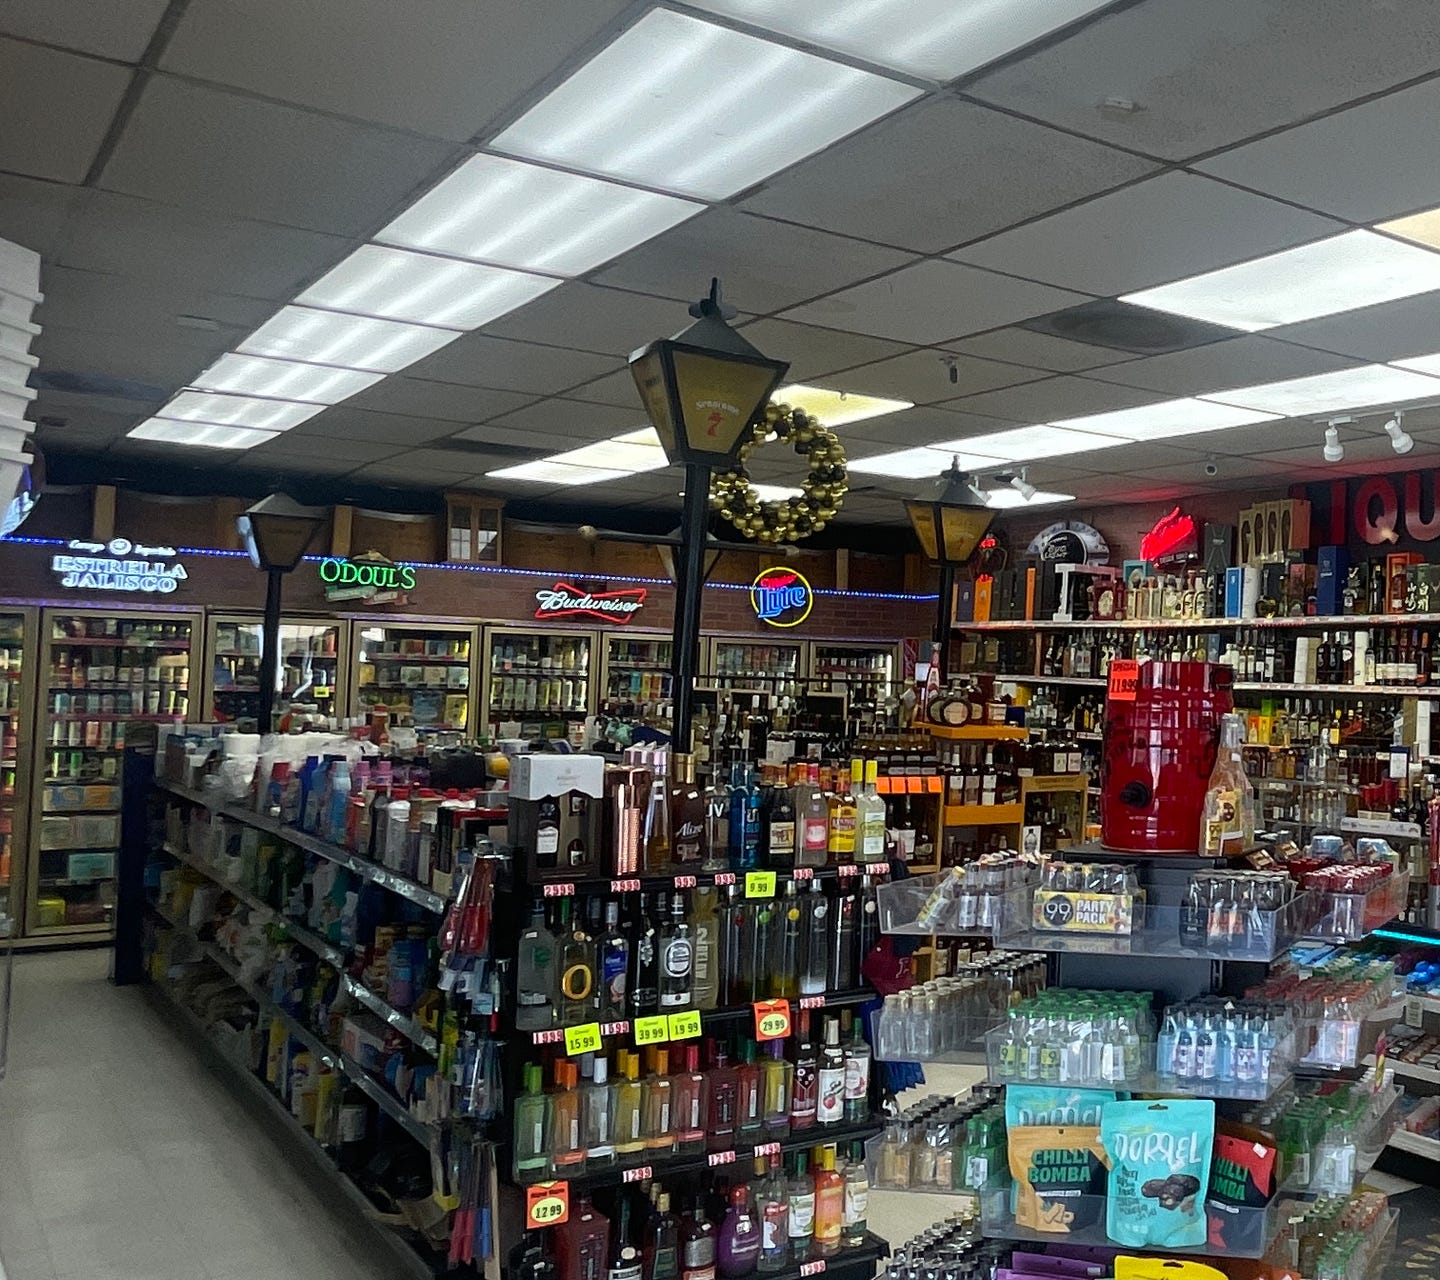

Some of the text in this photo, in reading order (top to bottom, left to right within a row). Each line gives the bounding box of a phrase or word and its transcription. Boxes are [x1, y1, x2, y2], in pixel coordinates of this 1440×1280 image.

[53, 555, 188, 579] ESTRELLA
[320, 558, 416, 589] O'DOUL'S
[62, 572, 178, 593] JALISCO
[535, 589, 643, 612] Budweiser
[757, 586, 806, 618] Lite
[1045, 902, 1071, 921] 99
[1076, 899, 1113, 912] PARTY
[1076, 911, 1106, 924] PACK
[1031, 1148, 1090, 1166] CHILLI
[1027, 1166, 1092, 1183] BOMBA
[1213, 1158, 1250, 1182] HILLI
[1211, 1177, 1245, 1201] OMBA
